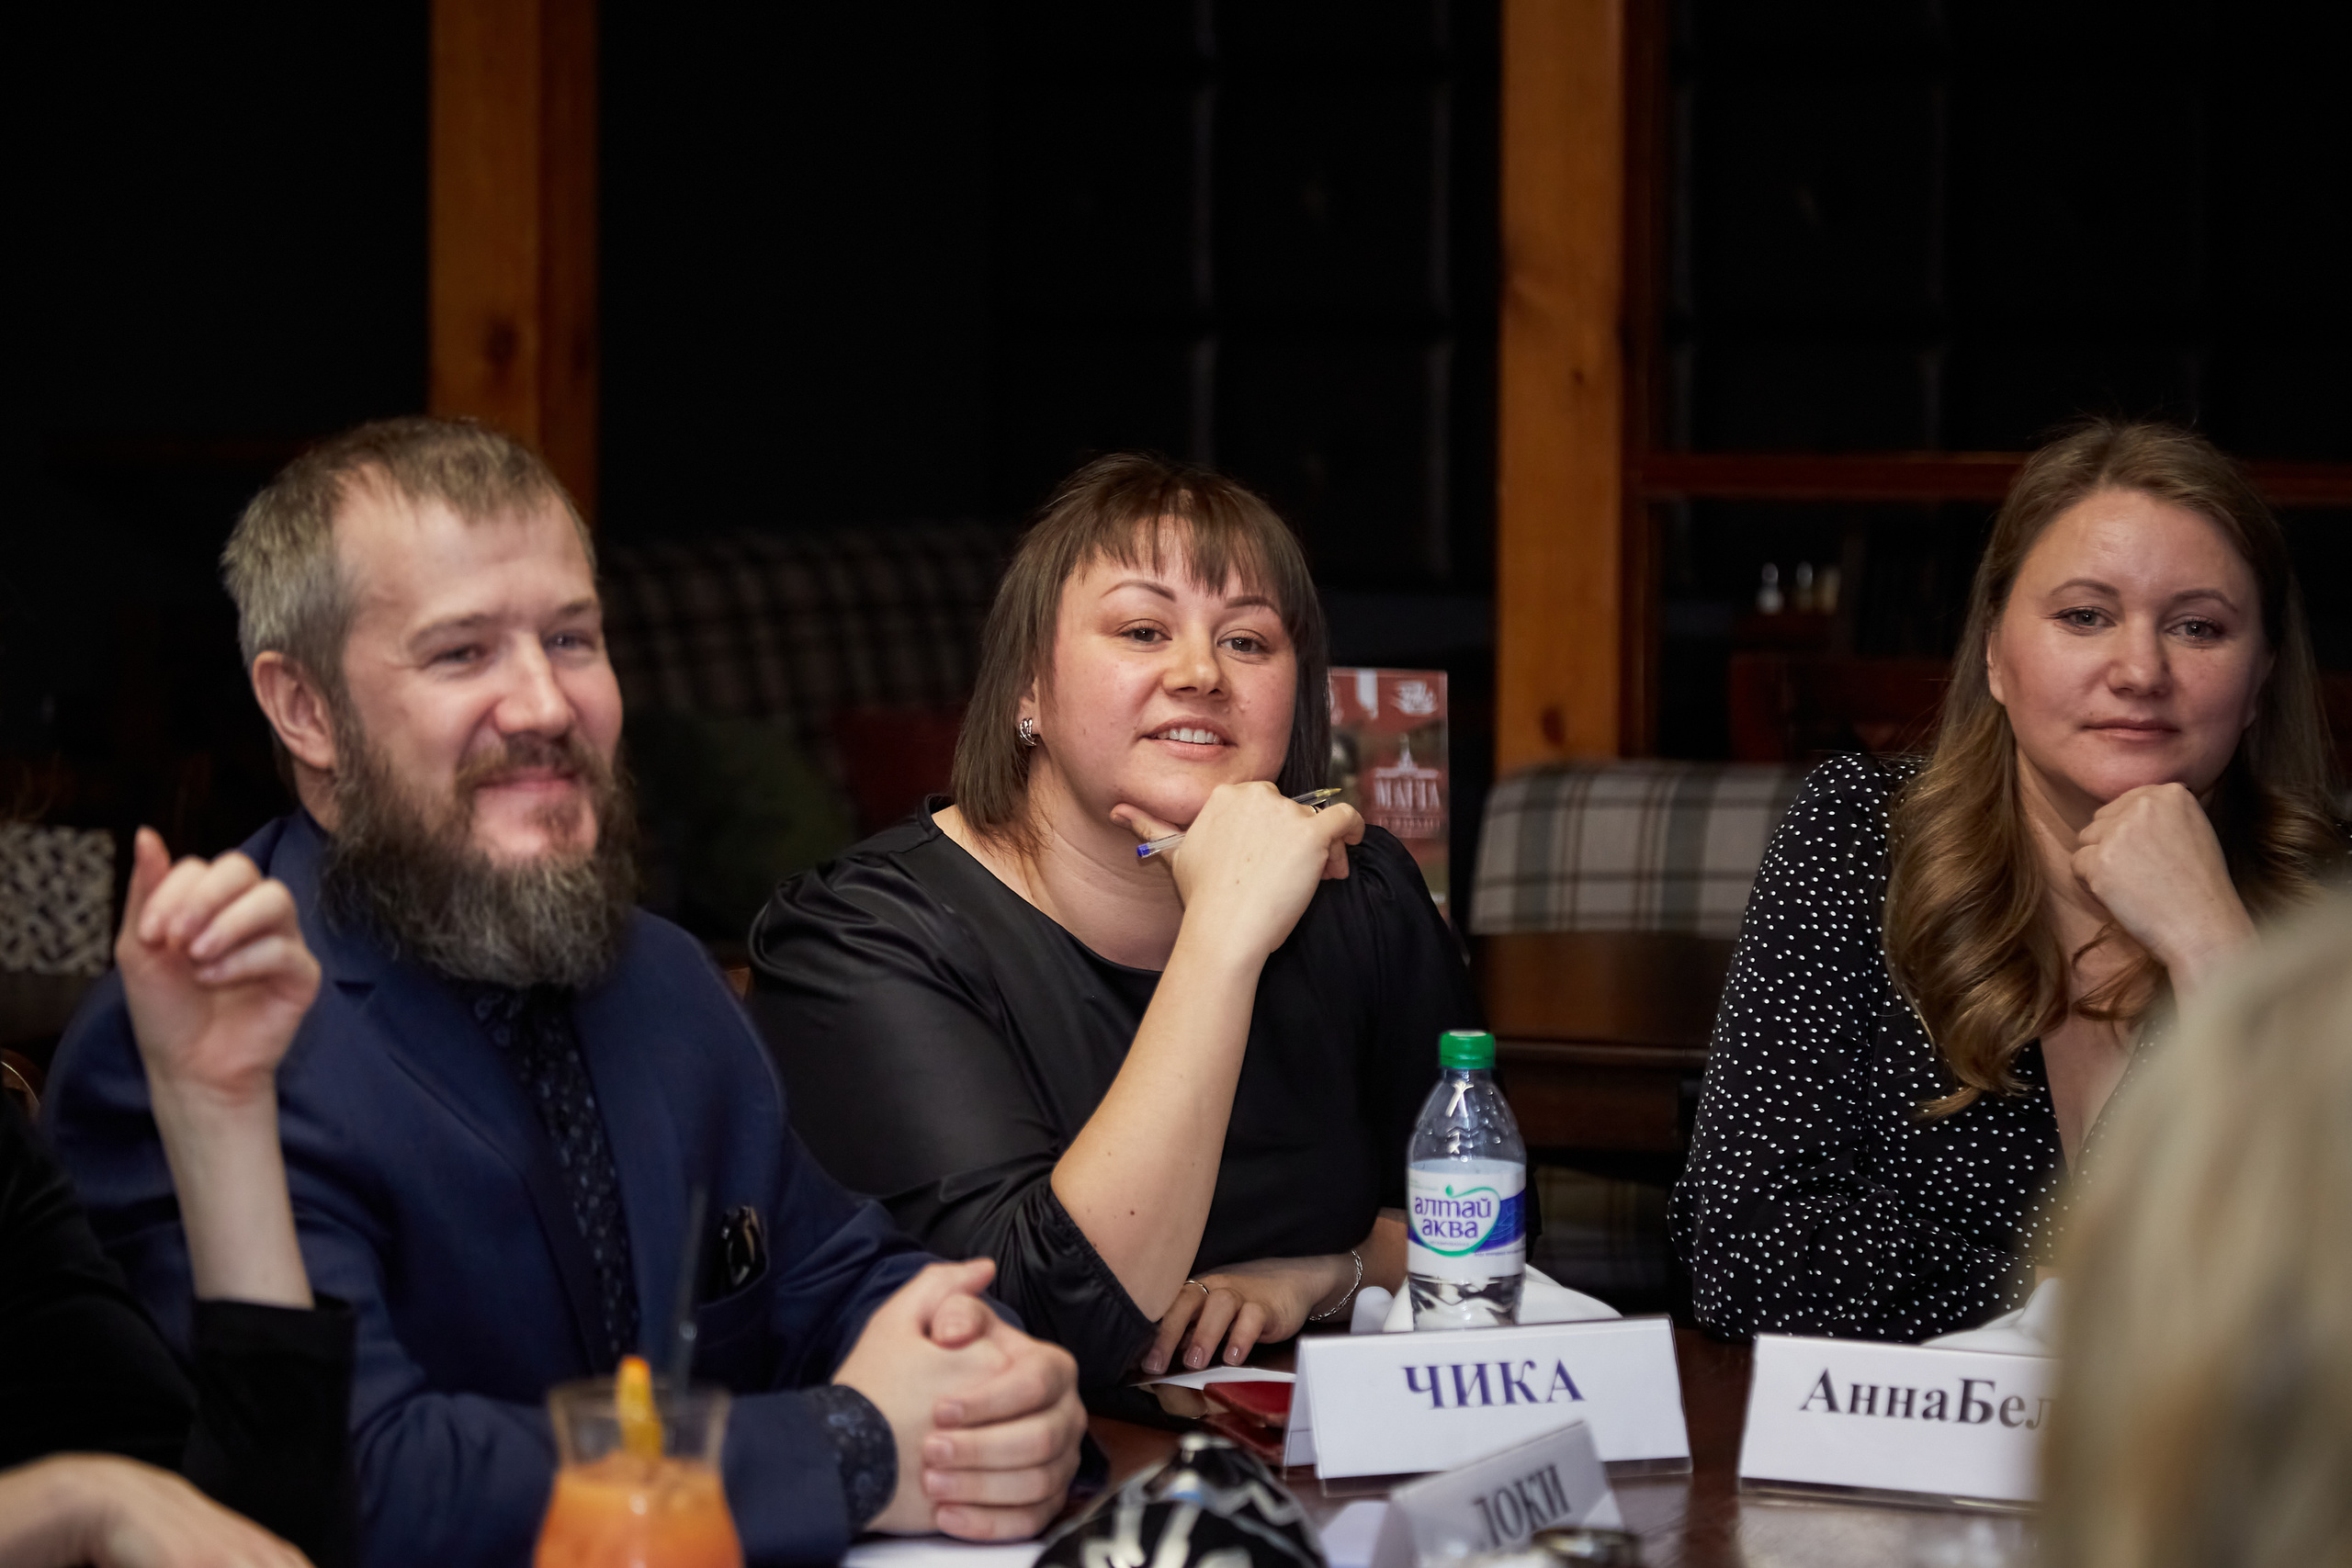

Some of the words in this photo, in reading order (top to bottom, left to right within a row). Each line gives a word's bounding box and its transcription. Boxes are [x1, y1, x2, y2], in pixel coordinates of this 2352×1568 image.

[1415, 1197, 1491, 1218] алтай
[1422, 1219, 1478, 1238] аква
[1402, 1359, 1586, 1409] ЧИКА
